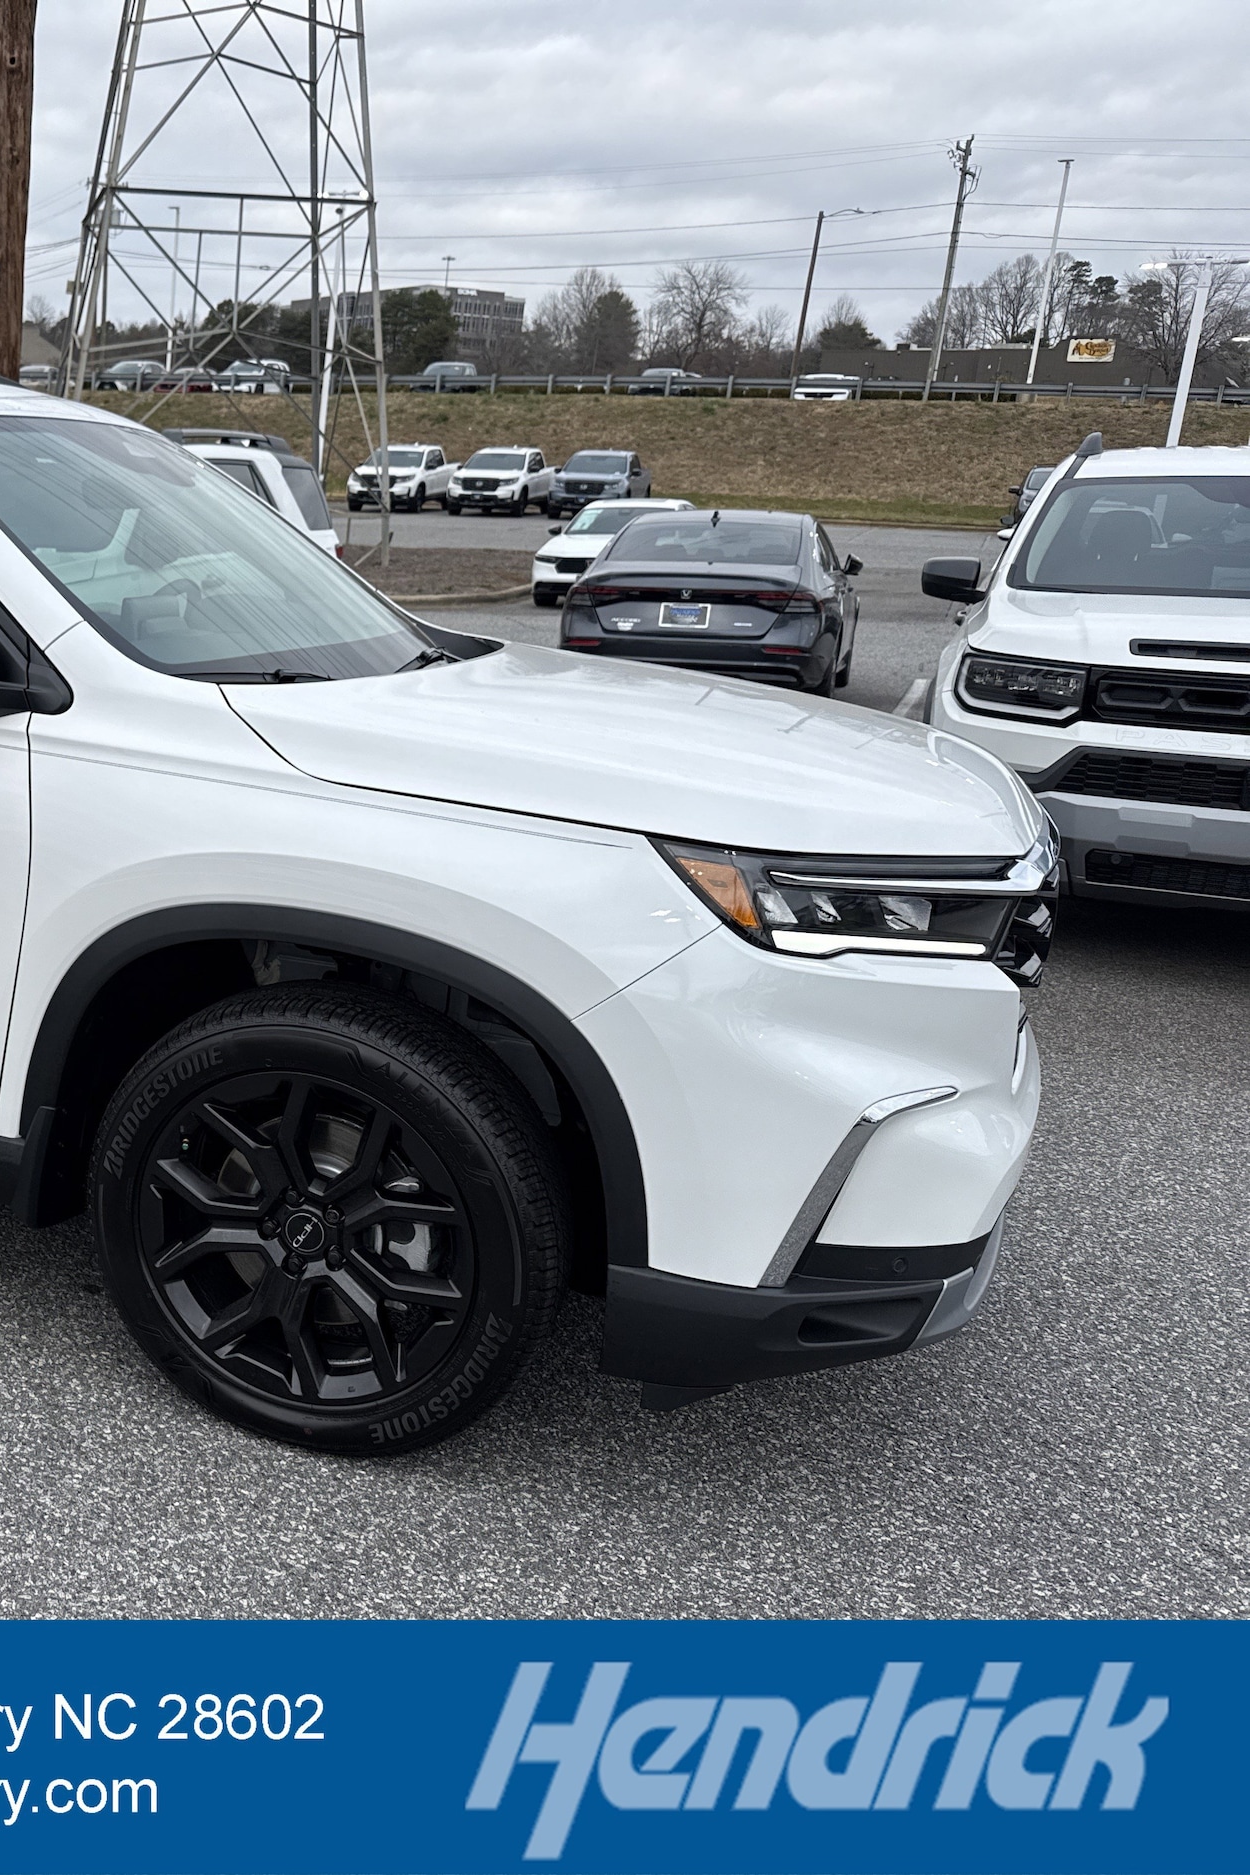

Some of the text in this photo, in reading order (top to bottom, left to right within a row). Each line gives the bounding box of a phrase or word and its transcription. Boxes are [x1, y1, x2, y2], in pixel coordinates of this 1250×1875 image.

[102, 1044, 224, 1181] BRIDGESTONE
[373, 1061, 478, 1160] ALENZA
[368, 1311, 514, 1445] BRIDGESTONE
